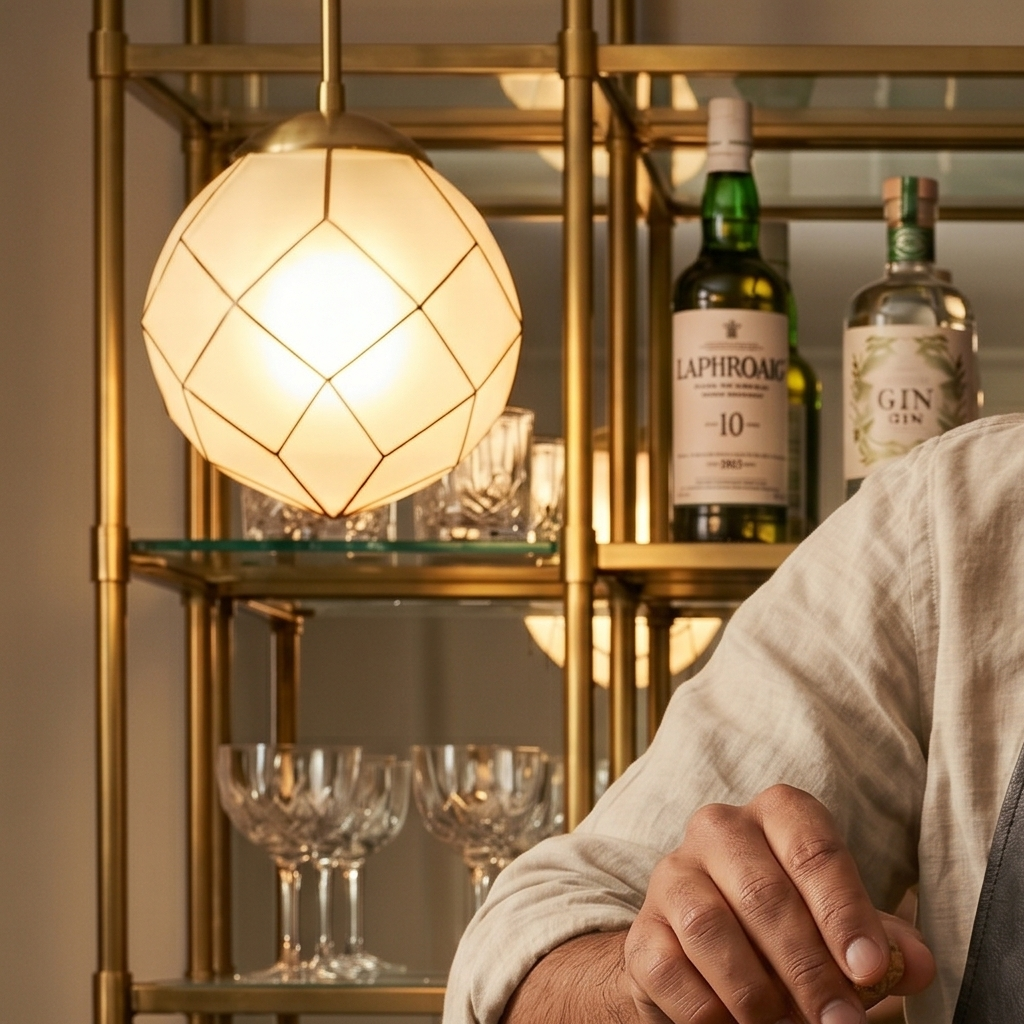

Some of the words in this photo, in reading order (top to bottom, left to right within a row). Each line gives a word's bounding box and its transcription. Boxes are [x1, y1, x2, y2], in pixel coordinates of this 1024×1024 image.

[676, 355, 786, 381] LAPHROAIG
[877, 388, 933, 410] GIN
[720, 412, 744, 437] 10
[889, 413, 922, 424] GIN
